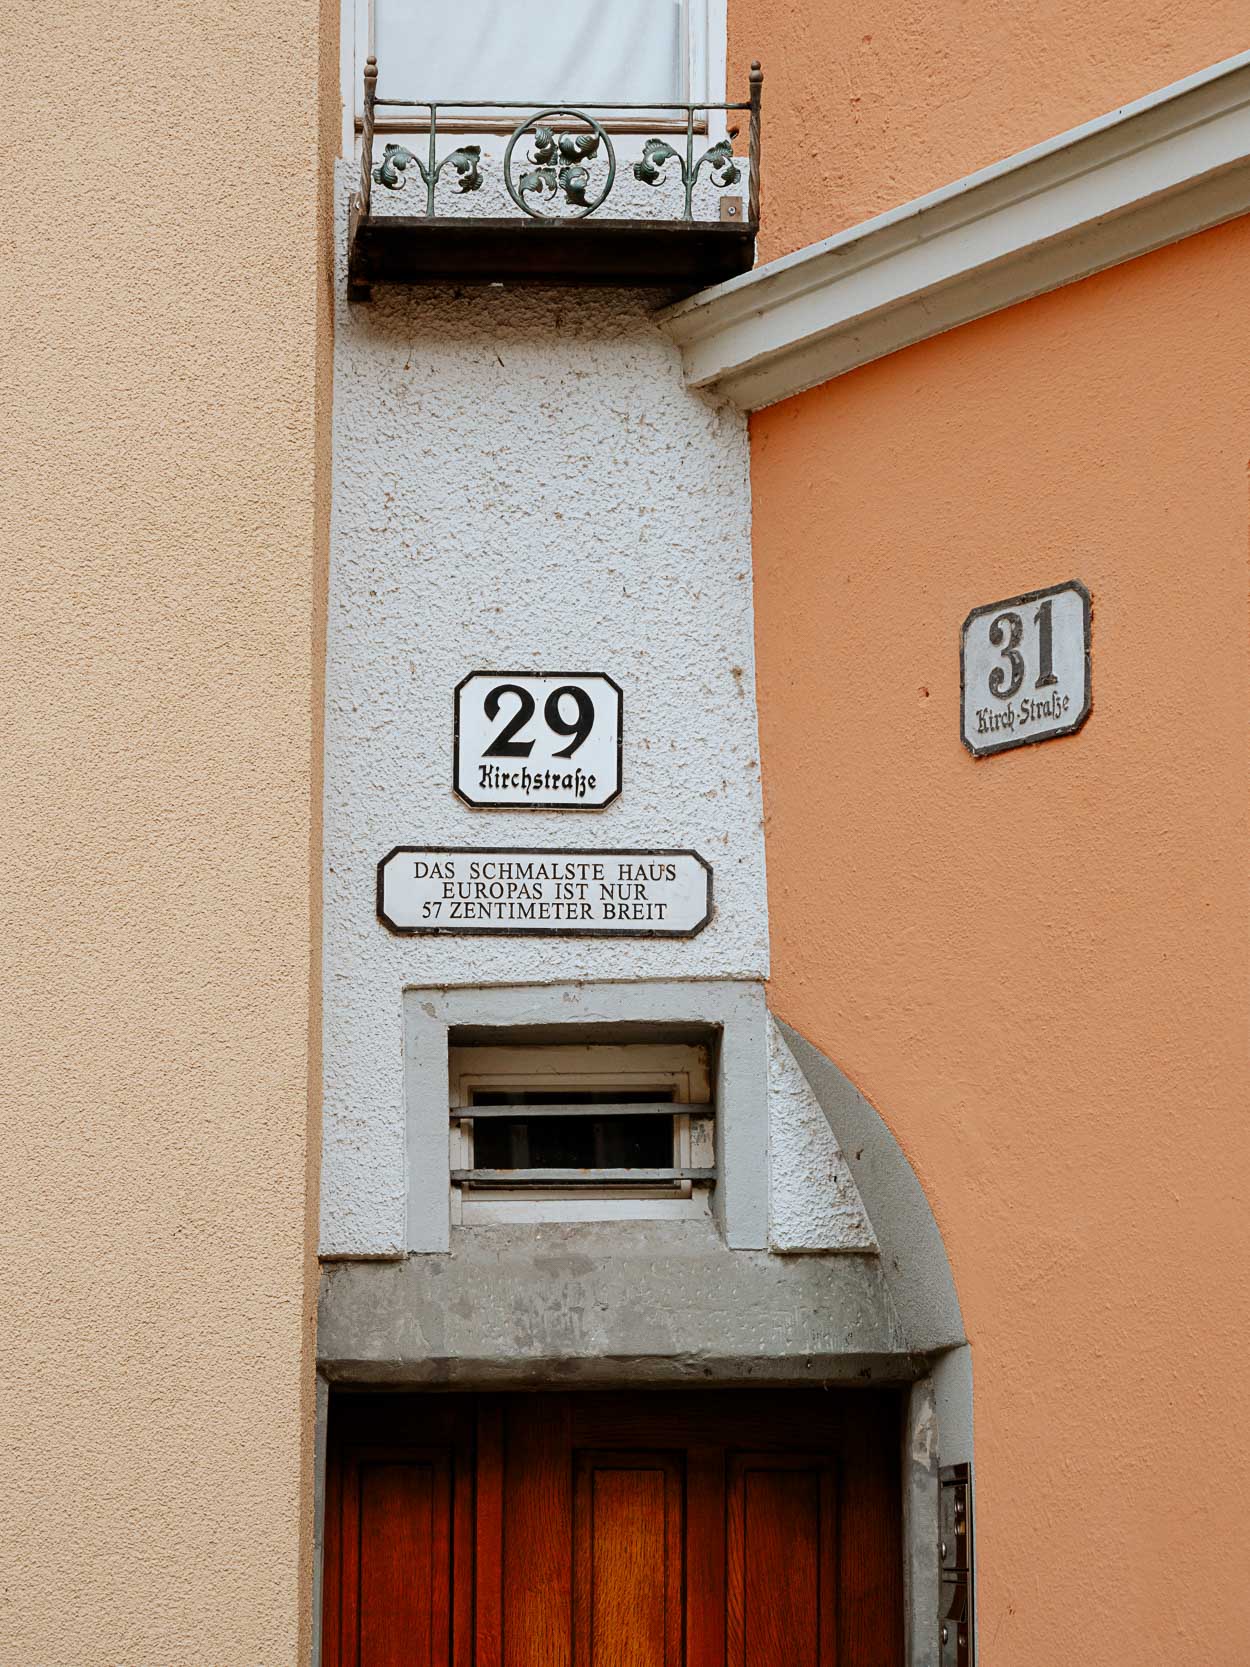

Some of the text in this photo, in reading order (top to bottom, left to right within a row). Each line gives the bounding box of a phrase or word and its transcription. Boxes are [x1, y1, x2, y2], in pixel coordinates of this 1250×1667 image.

[988, 599, 1058, 700] 31
[481, 684, 595, 759] 29
[478, 764, 597, 797] Kirchstraße
[414, 861, 676, 882] DAS SCHMALSTE HAUS
[441, 882, 648, 901] EUROPAS IST NUR
[422, 902, 668, 920] 57 ZENTIMETER BREIT
